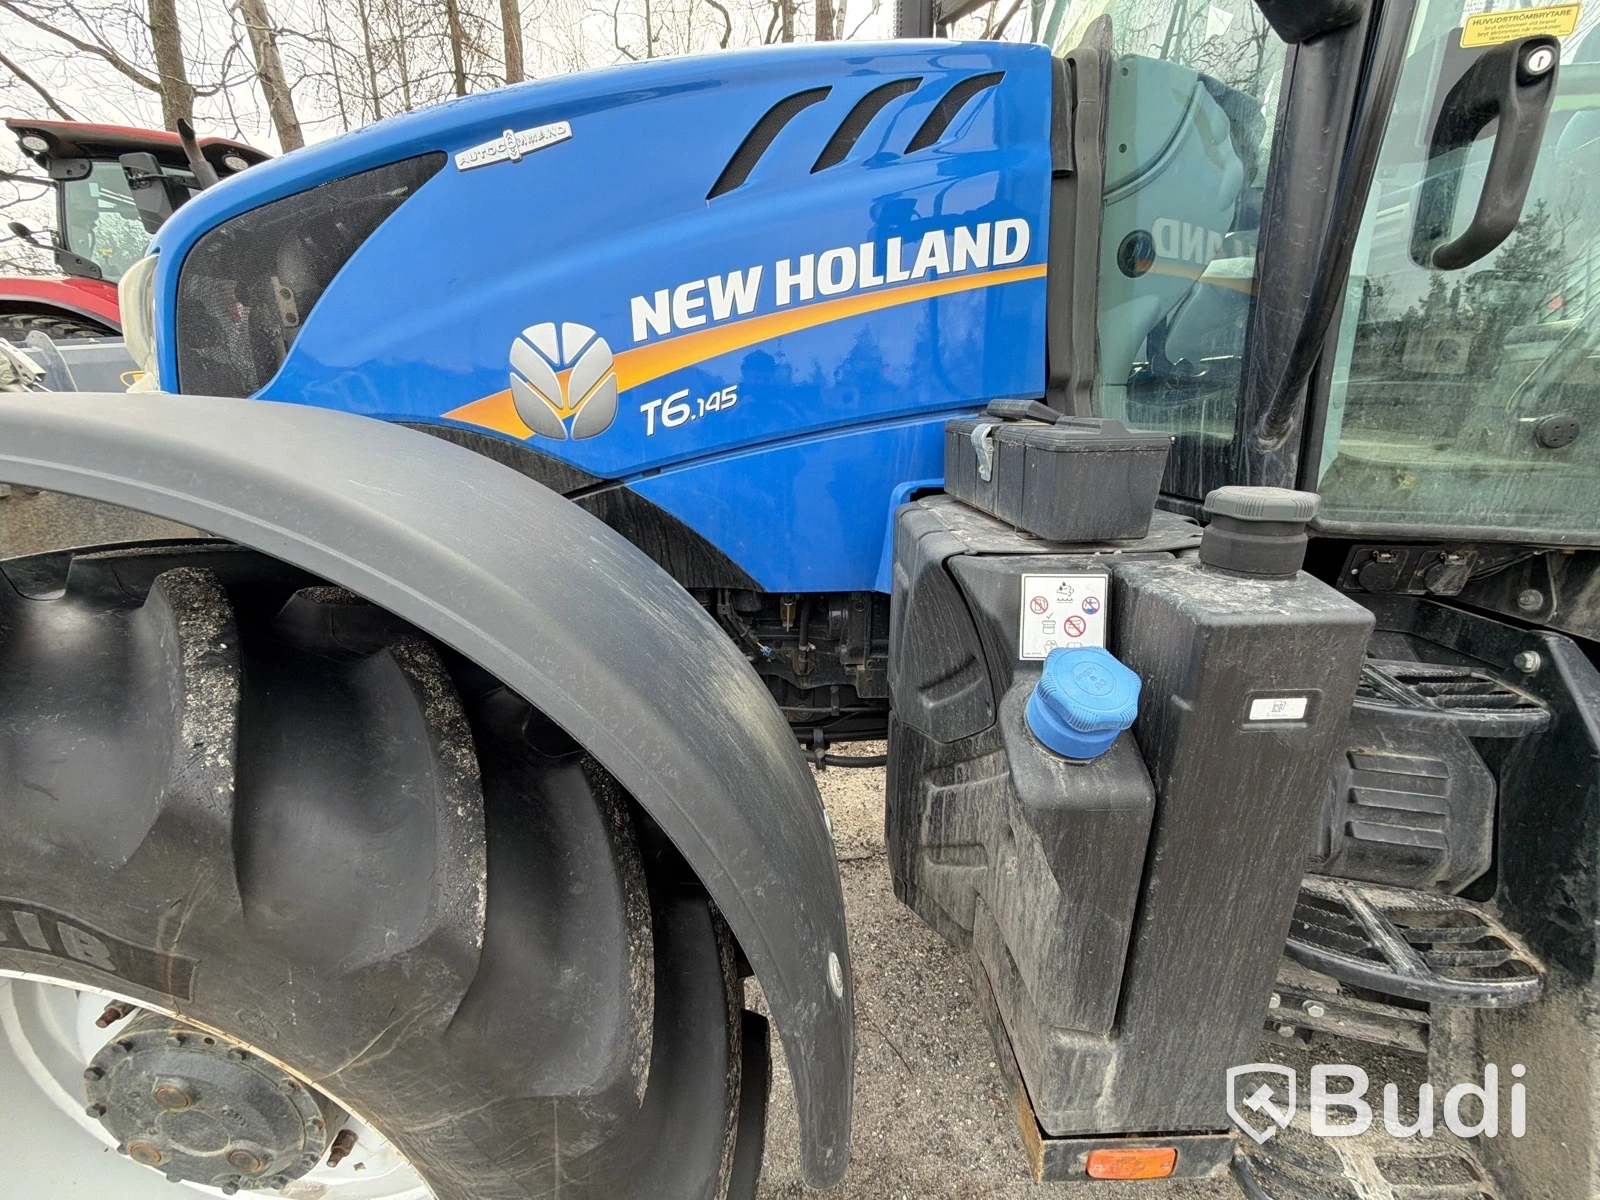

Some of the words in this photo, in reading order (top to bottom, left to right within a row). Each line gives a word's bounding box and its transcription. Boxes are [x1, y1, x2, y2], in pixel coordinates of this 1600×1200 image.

[1472, 9, 1572, 26] HUVUDSTRÖMBRYTARE
[630, 264, 764, 342] NEW
[775, 217, 1031, 306] HOLLAND
[640, 384, 738, 437] T6.145
